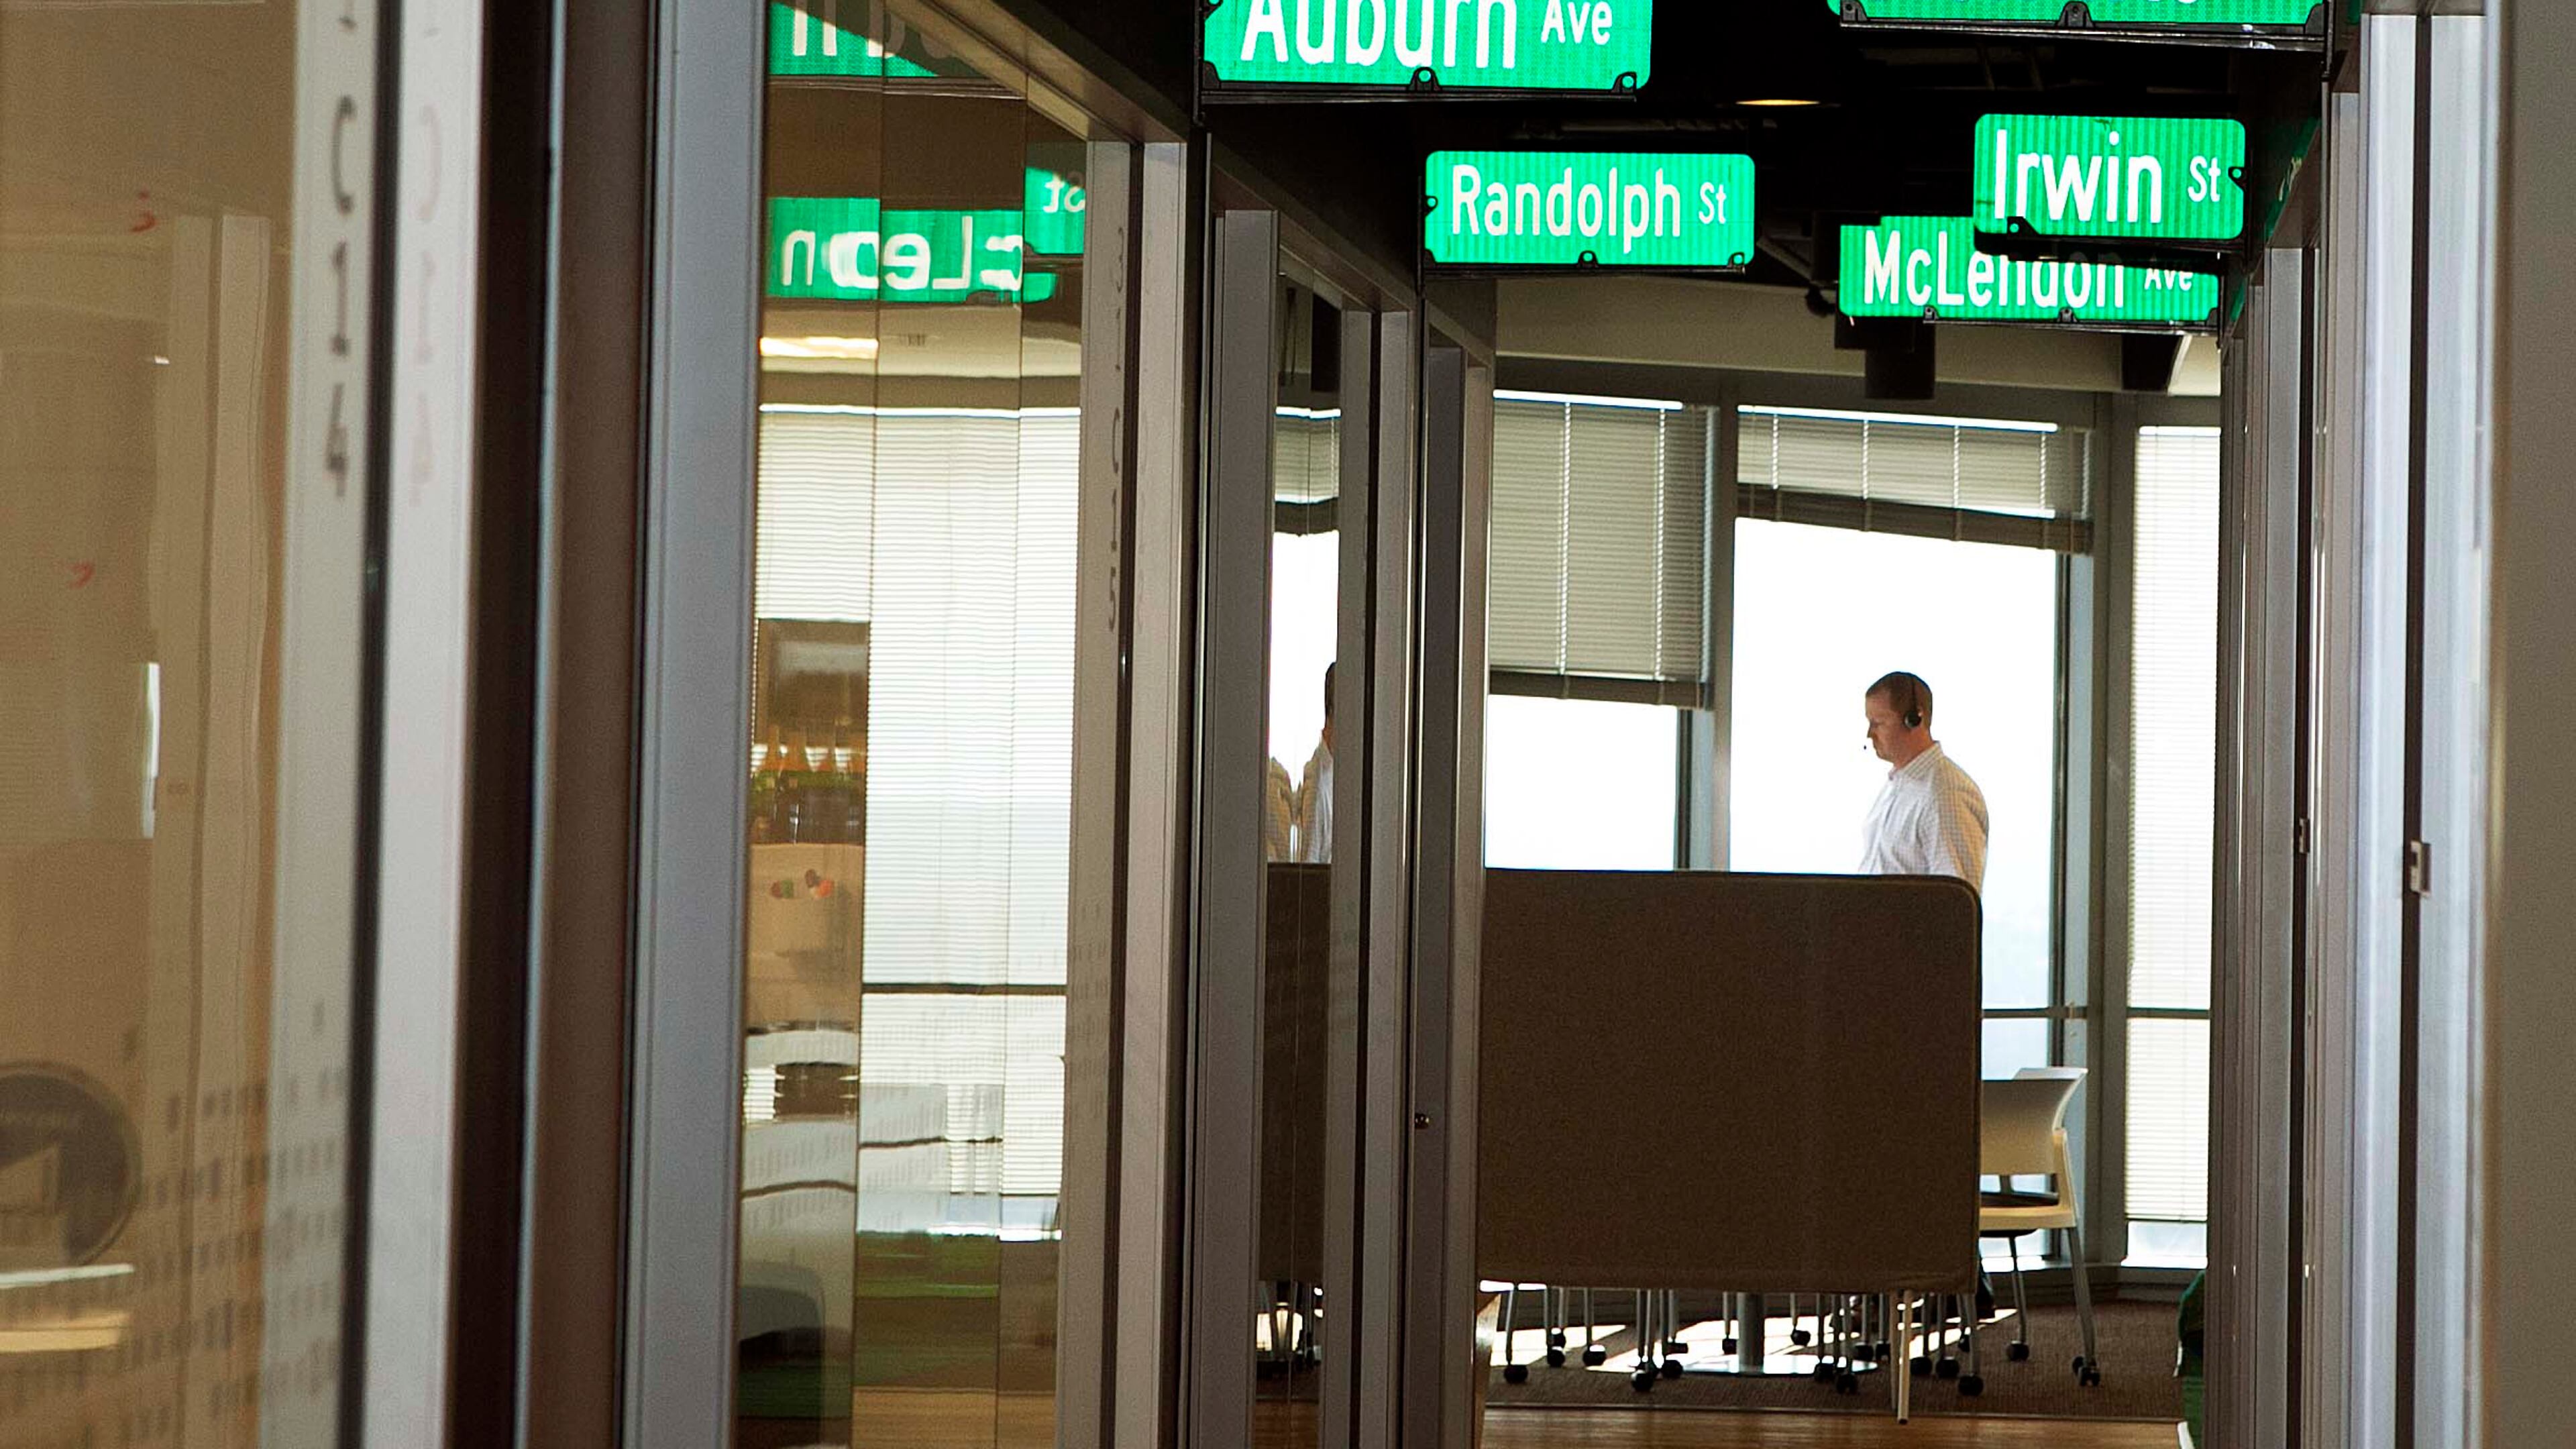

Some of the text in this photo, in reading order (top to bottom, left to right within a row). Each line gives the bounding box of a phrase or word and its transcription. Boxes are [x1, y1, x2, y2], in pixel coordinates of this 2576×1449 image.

[1240, 0, 1613, 70] Auburn Ave
[1452, 164, 1729, 255] Randolph St
[1994, 128, 2163, 225] Irwin
[2187, 155, 2222, 203] St
[1864, 229, 2194, 309] McLendon Ave
